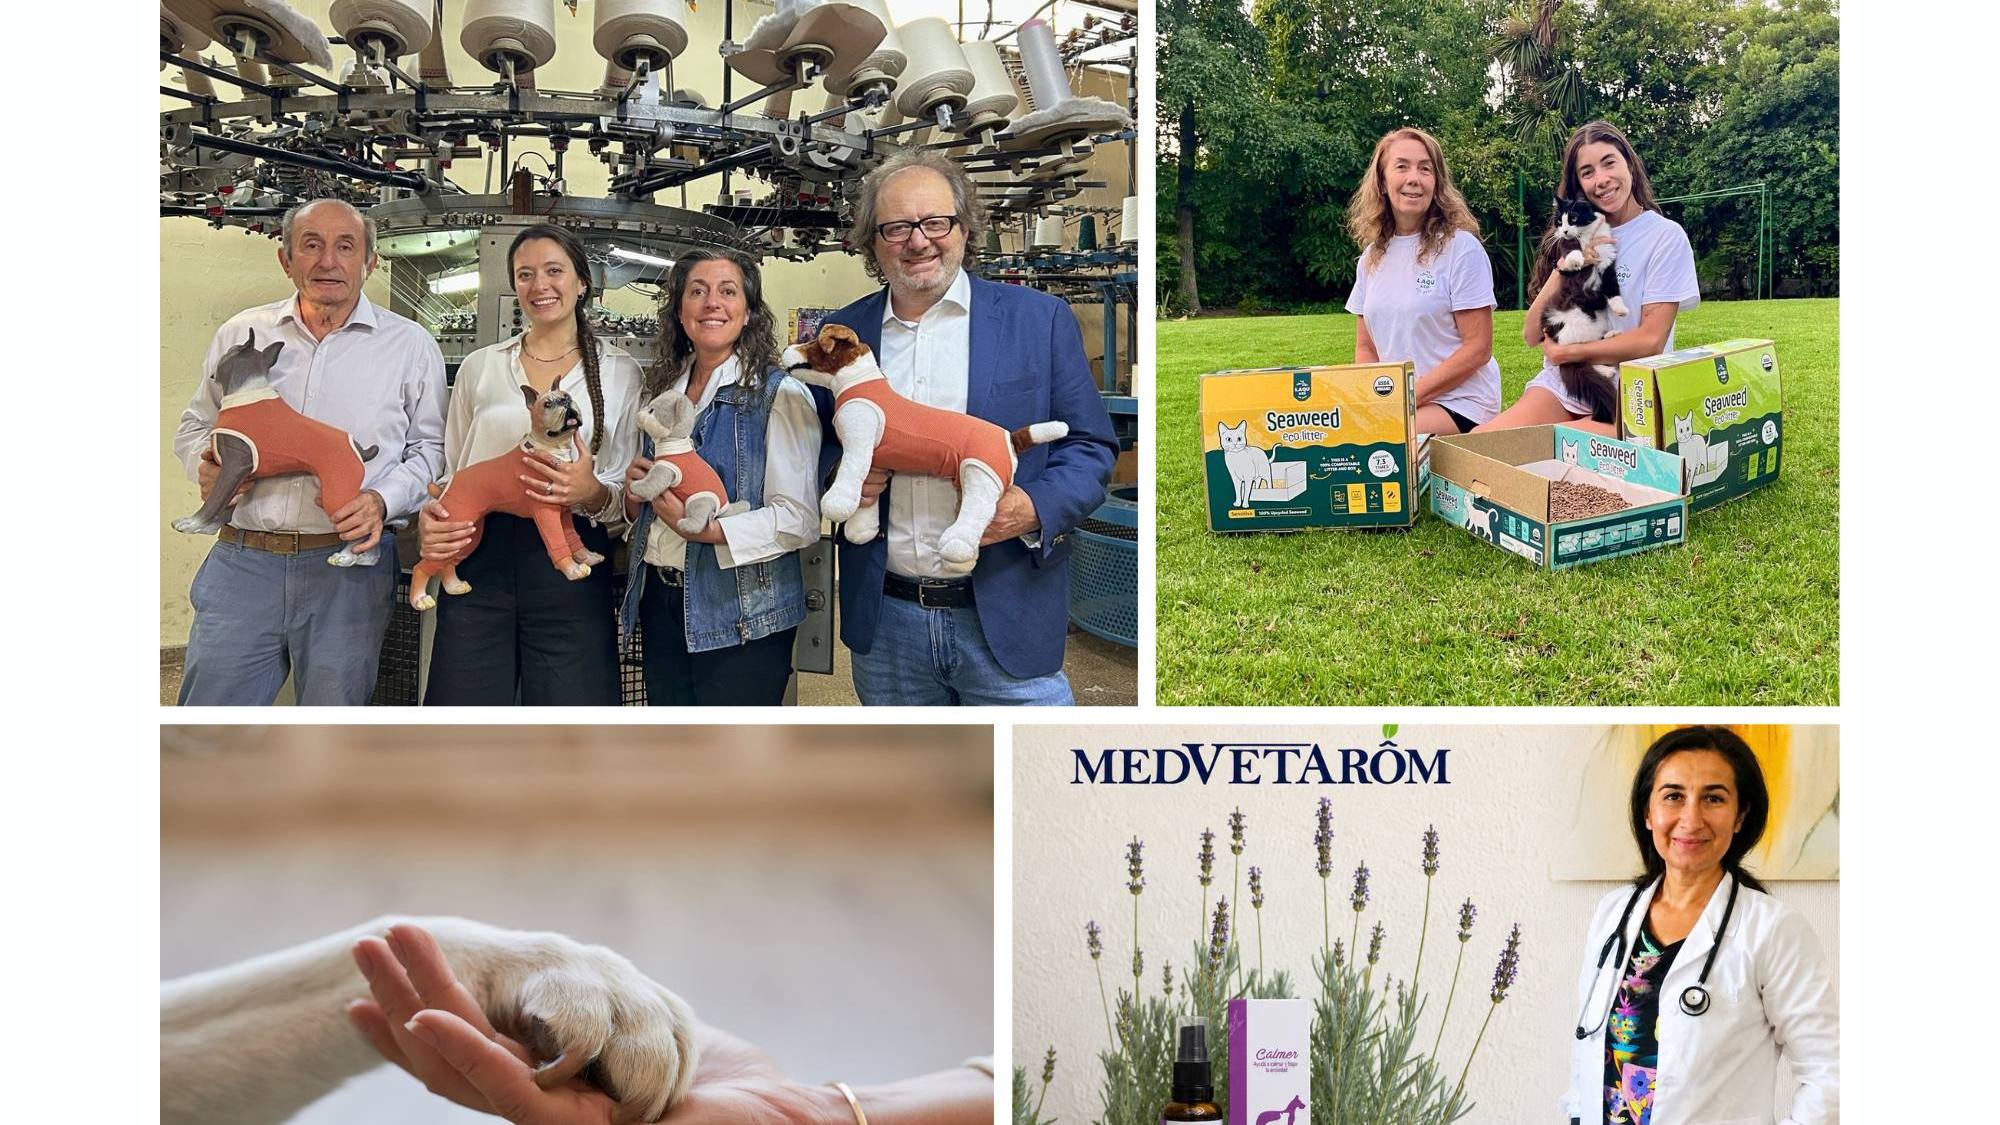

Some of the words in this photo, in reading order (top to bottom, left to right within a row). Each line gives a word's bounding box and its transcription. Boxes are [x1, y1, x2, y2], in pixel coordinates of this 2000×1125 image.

[1634, 379, 1646, 426] Seaweed
[1705, 387, 1747, 417] Seaweed
[1267, 407, 1340, 431] Seaweed
[1591, 439, 1636, 468] Seaweed
[1256, 1048, 1298, 1061] Calmer
